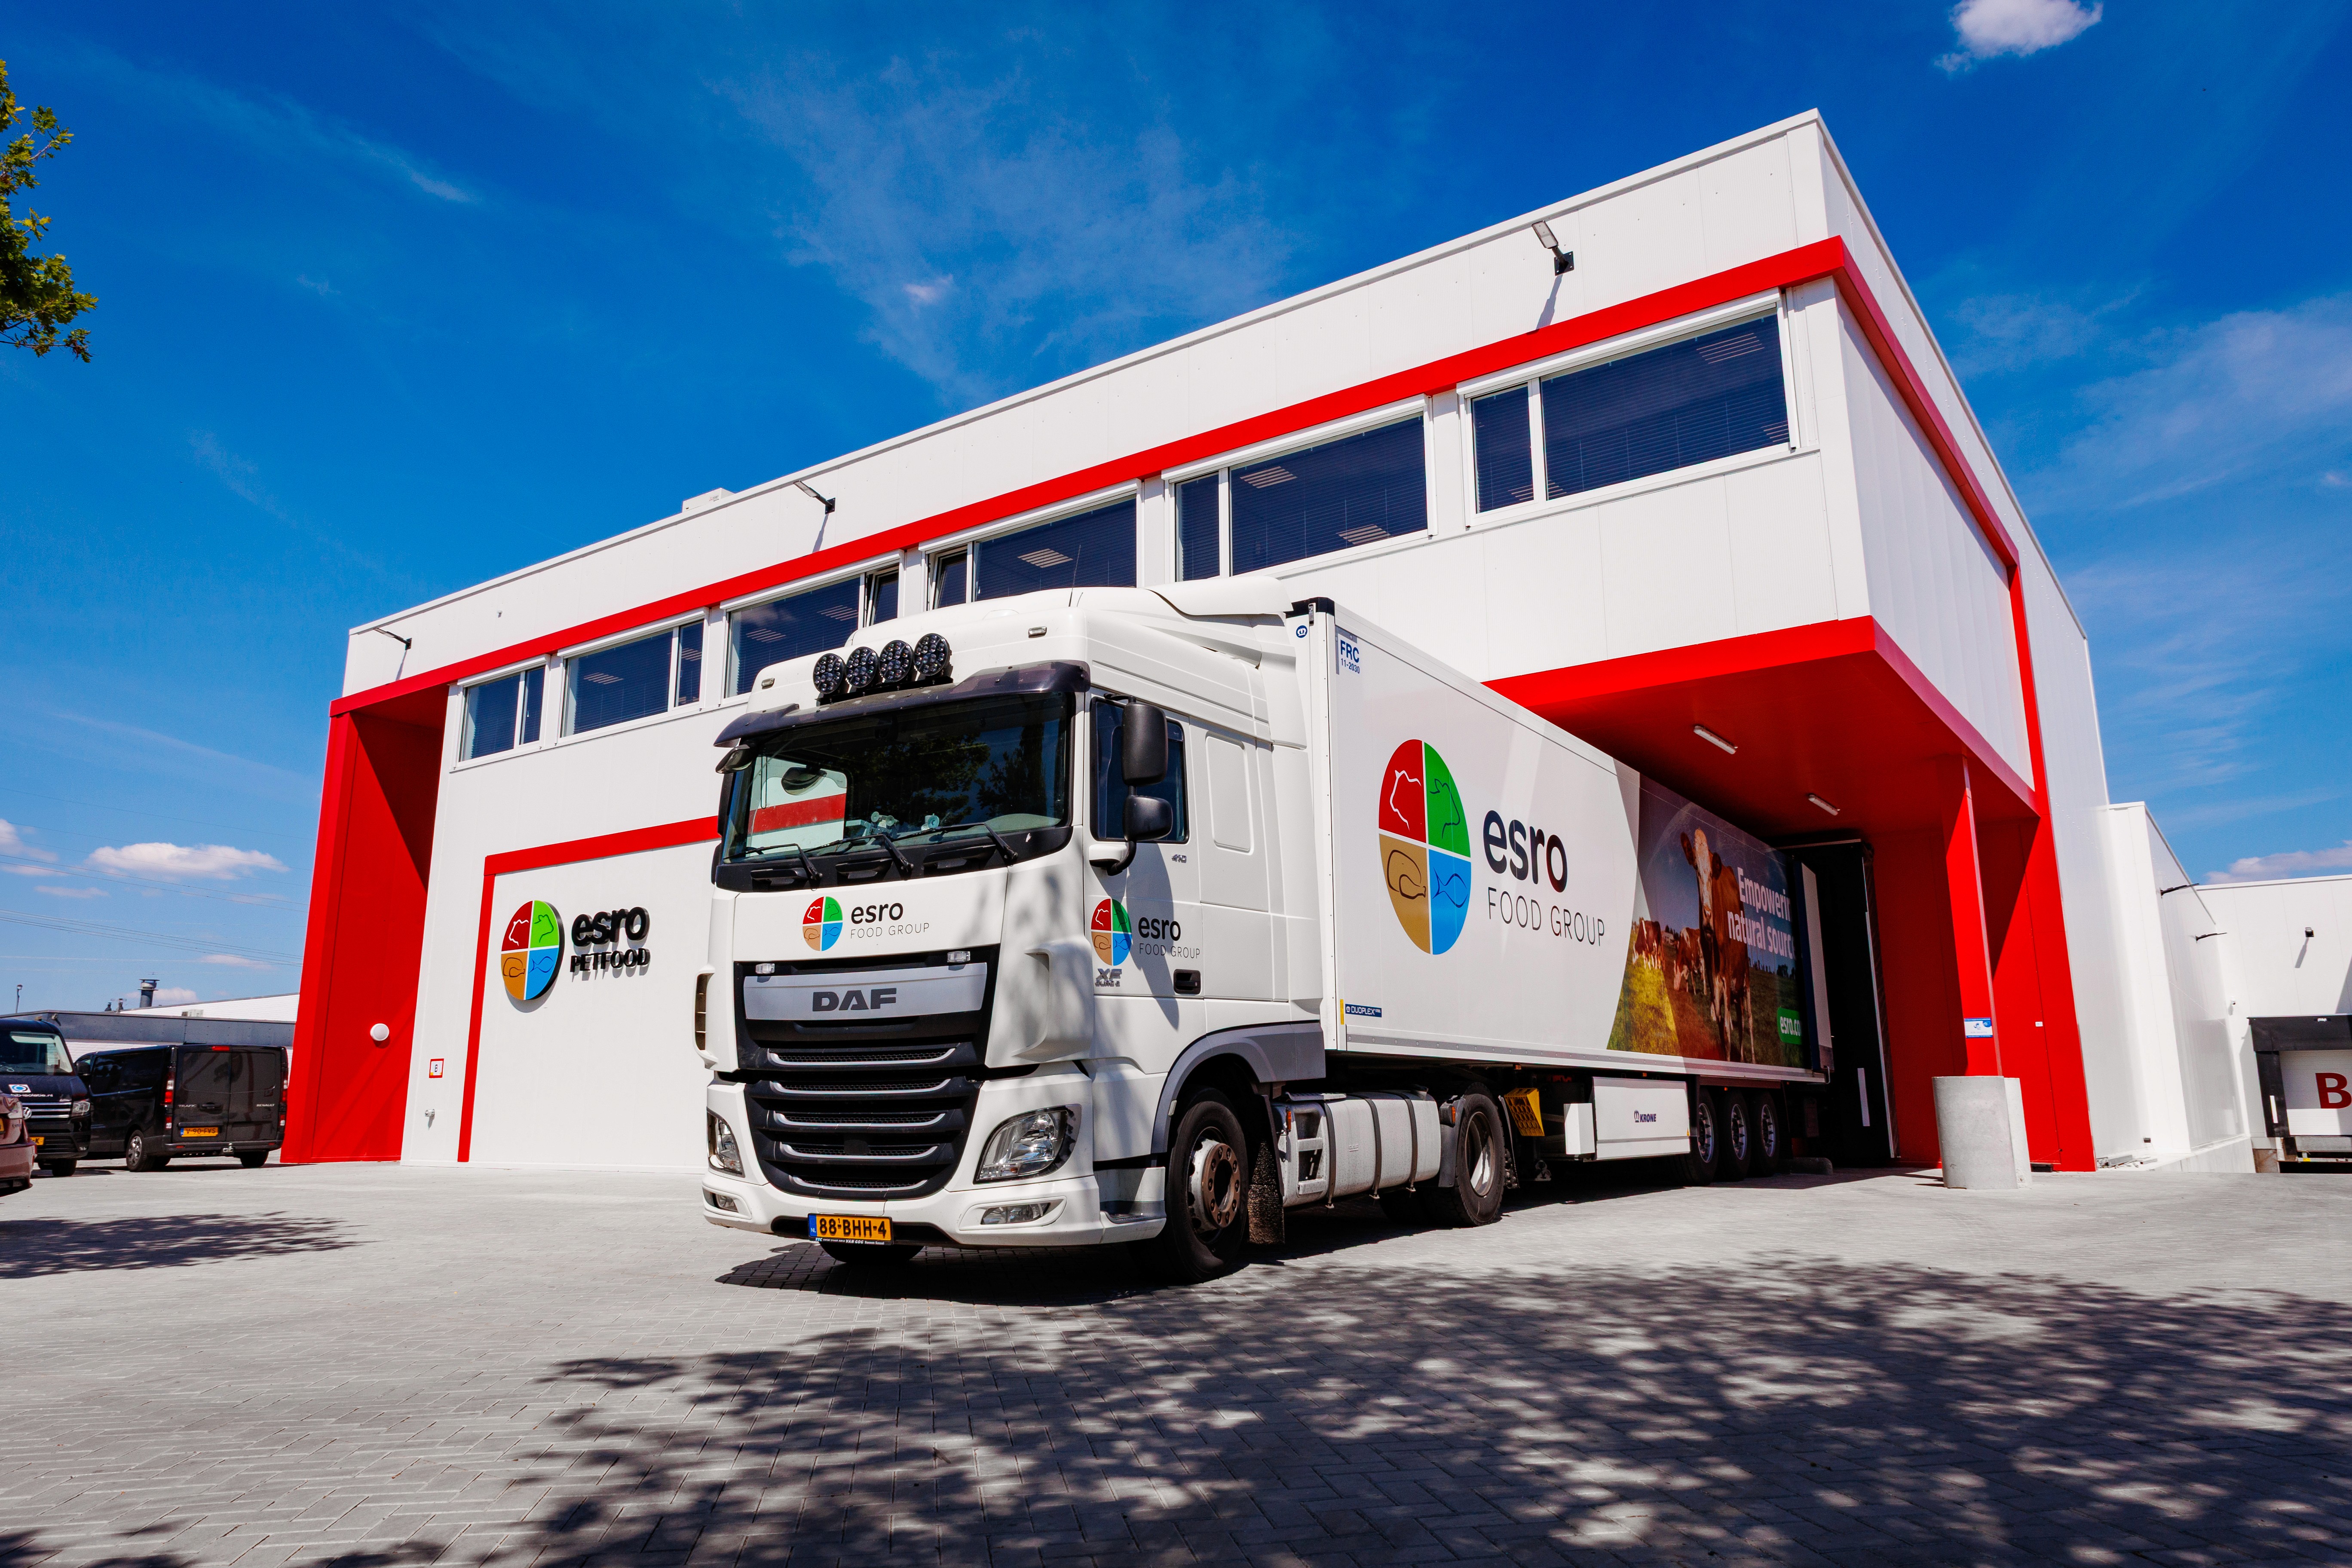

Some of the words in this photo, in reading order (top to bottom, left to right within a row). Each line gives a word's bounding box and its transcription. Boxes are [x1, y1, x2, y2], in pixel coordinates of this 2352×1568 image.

[1340, 640, 1360, 663] FRC
[1341, 658, 1360, 674] 11-2030
[1483, 810, 1568, 893] esro
[851, 903, 903, 924] esro
[1488, 887, 1541, 931] FOOD
[1550, 905, 1605, 946] GROUP
[571, 906, 650, 947] esro
[851, 927, 882, 939] FOOD
[888, 922, 929, 935] GROUP
[1138, 917, 1181, 941] esro
[1727, 910, 1766, 950] natural
[570, 948, 650, 973] PETFOOD
[1139, 943, 1166, 956] FOOD
[1170, 946, 1200, 959] GROUP
[1096, 968, 1122, 980] XF
[812, 988, 897, 1012] DAF
[1351, 1006, 1375, 1015] DUOPLEX
[1780, 1016, 1801, 1037] esro.co
[2315, 1072, 2352, 1109] B
[1640, 1113, 1657, 1123] KRONE
[819, 1218, 887, 1238] 88-BHH-4
